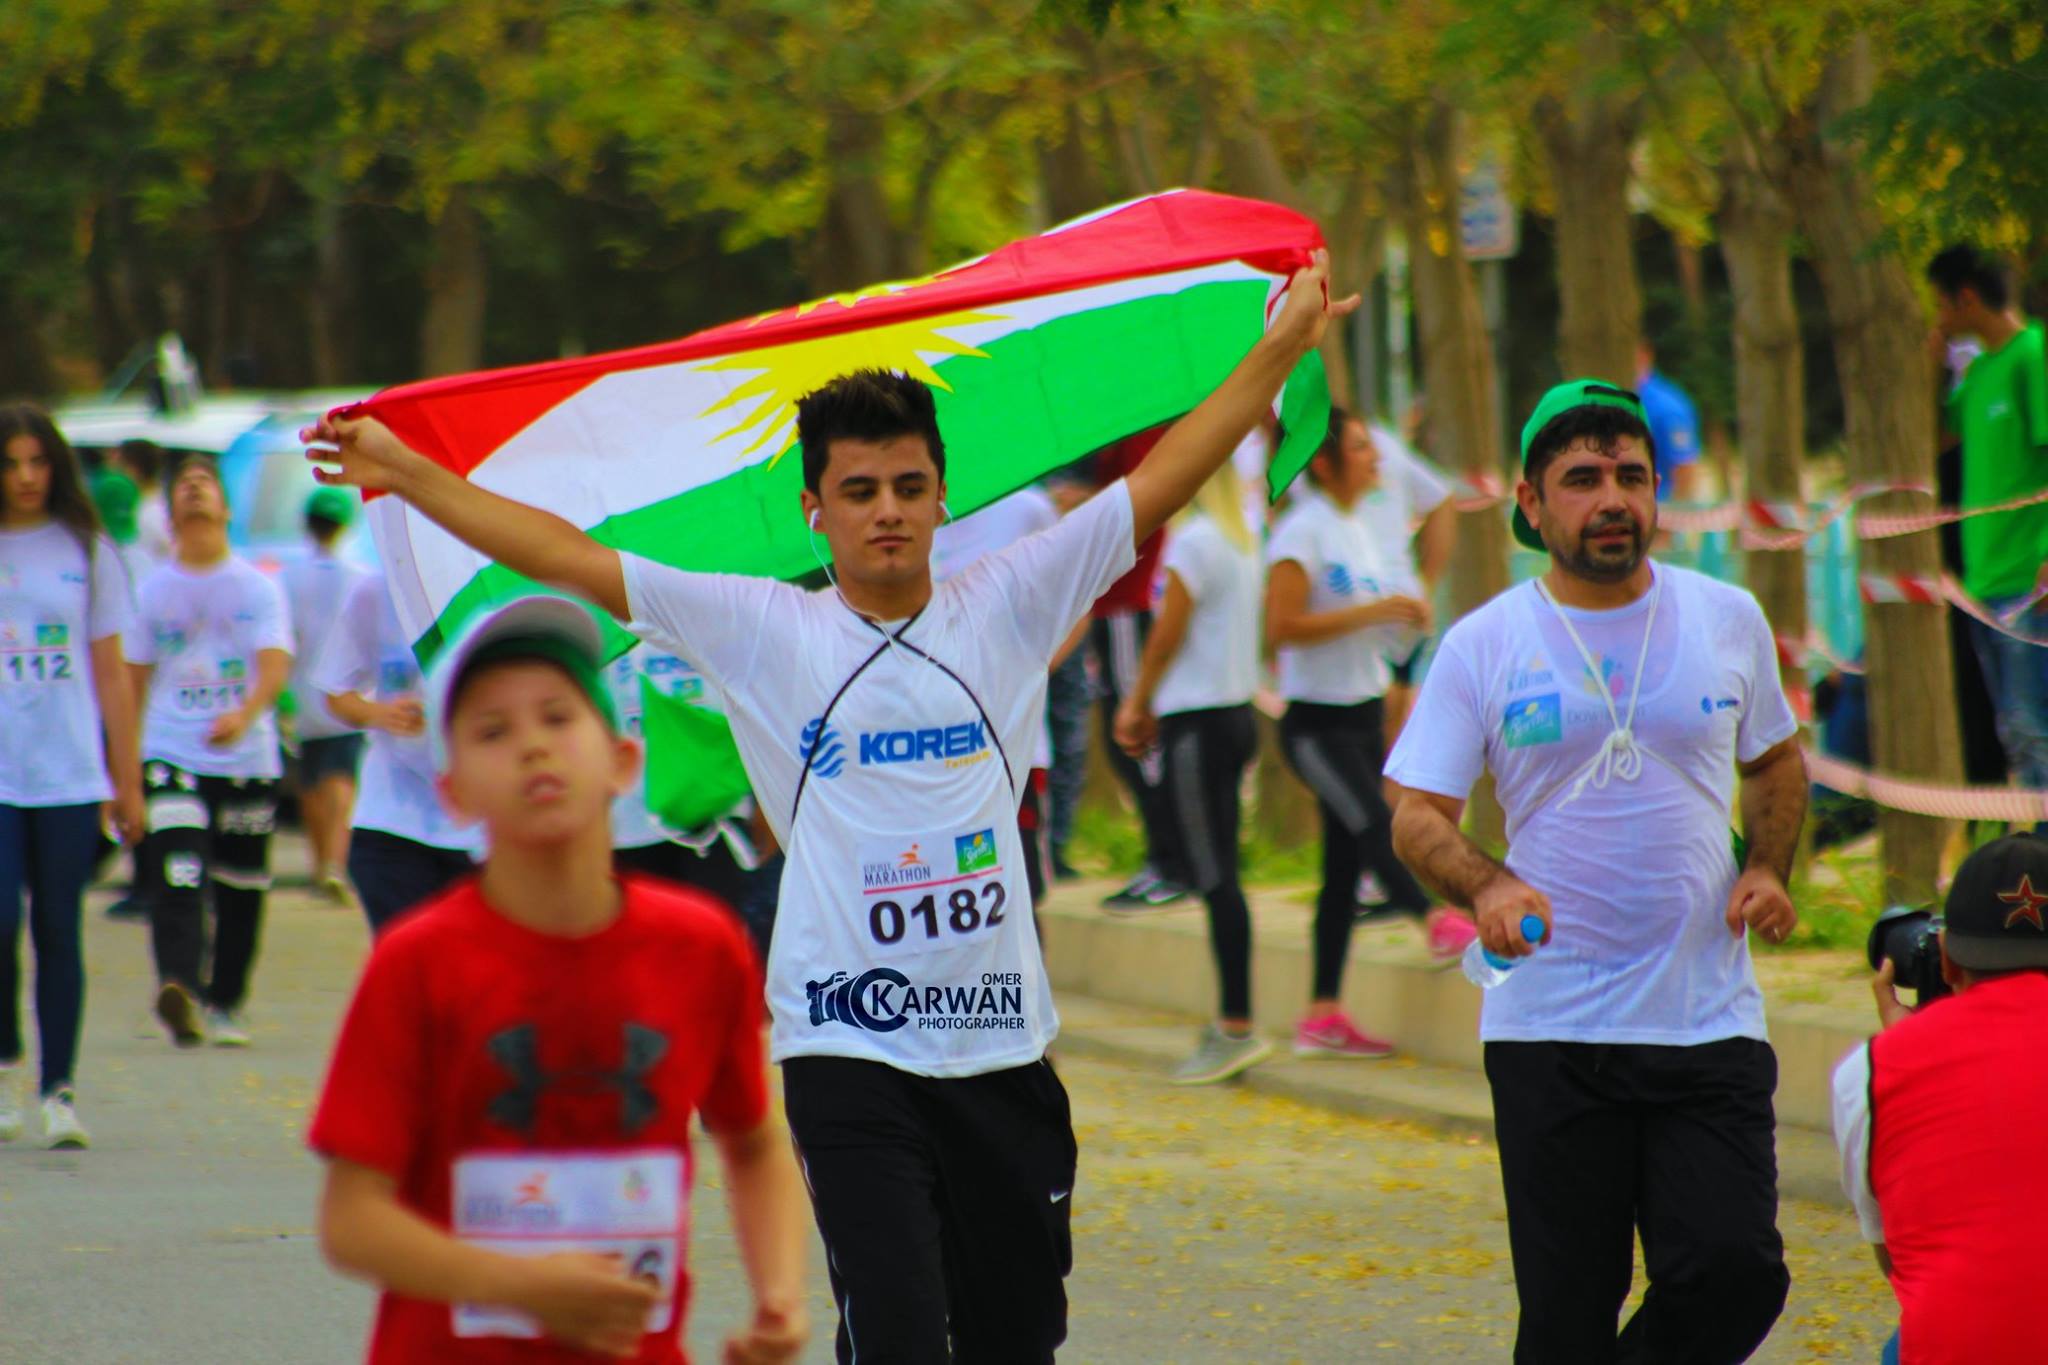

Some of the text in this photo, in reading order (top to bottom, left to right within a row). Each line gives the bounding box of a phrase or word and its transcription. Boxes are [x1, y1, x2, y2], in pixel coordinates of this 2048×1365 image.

[859, 719, 988, 766] KOREK
[864, 865, 932, 887] MARATHON
[869, 881, 1007, 946] 0182
